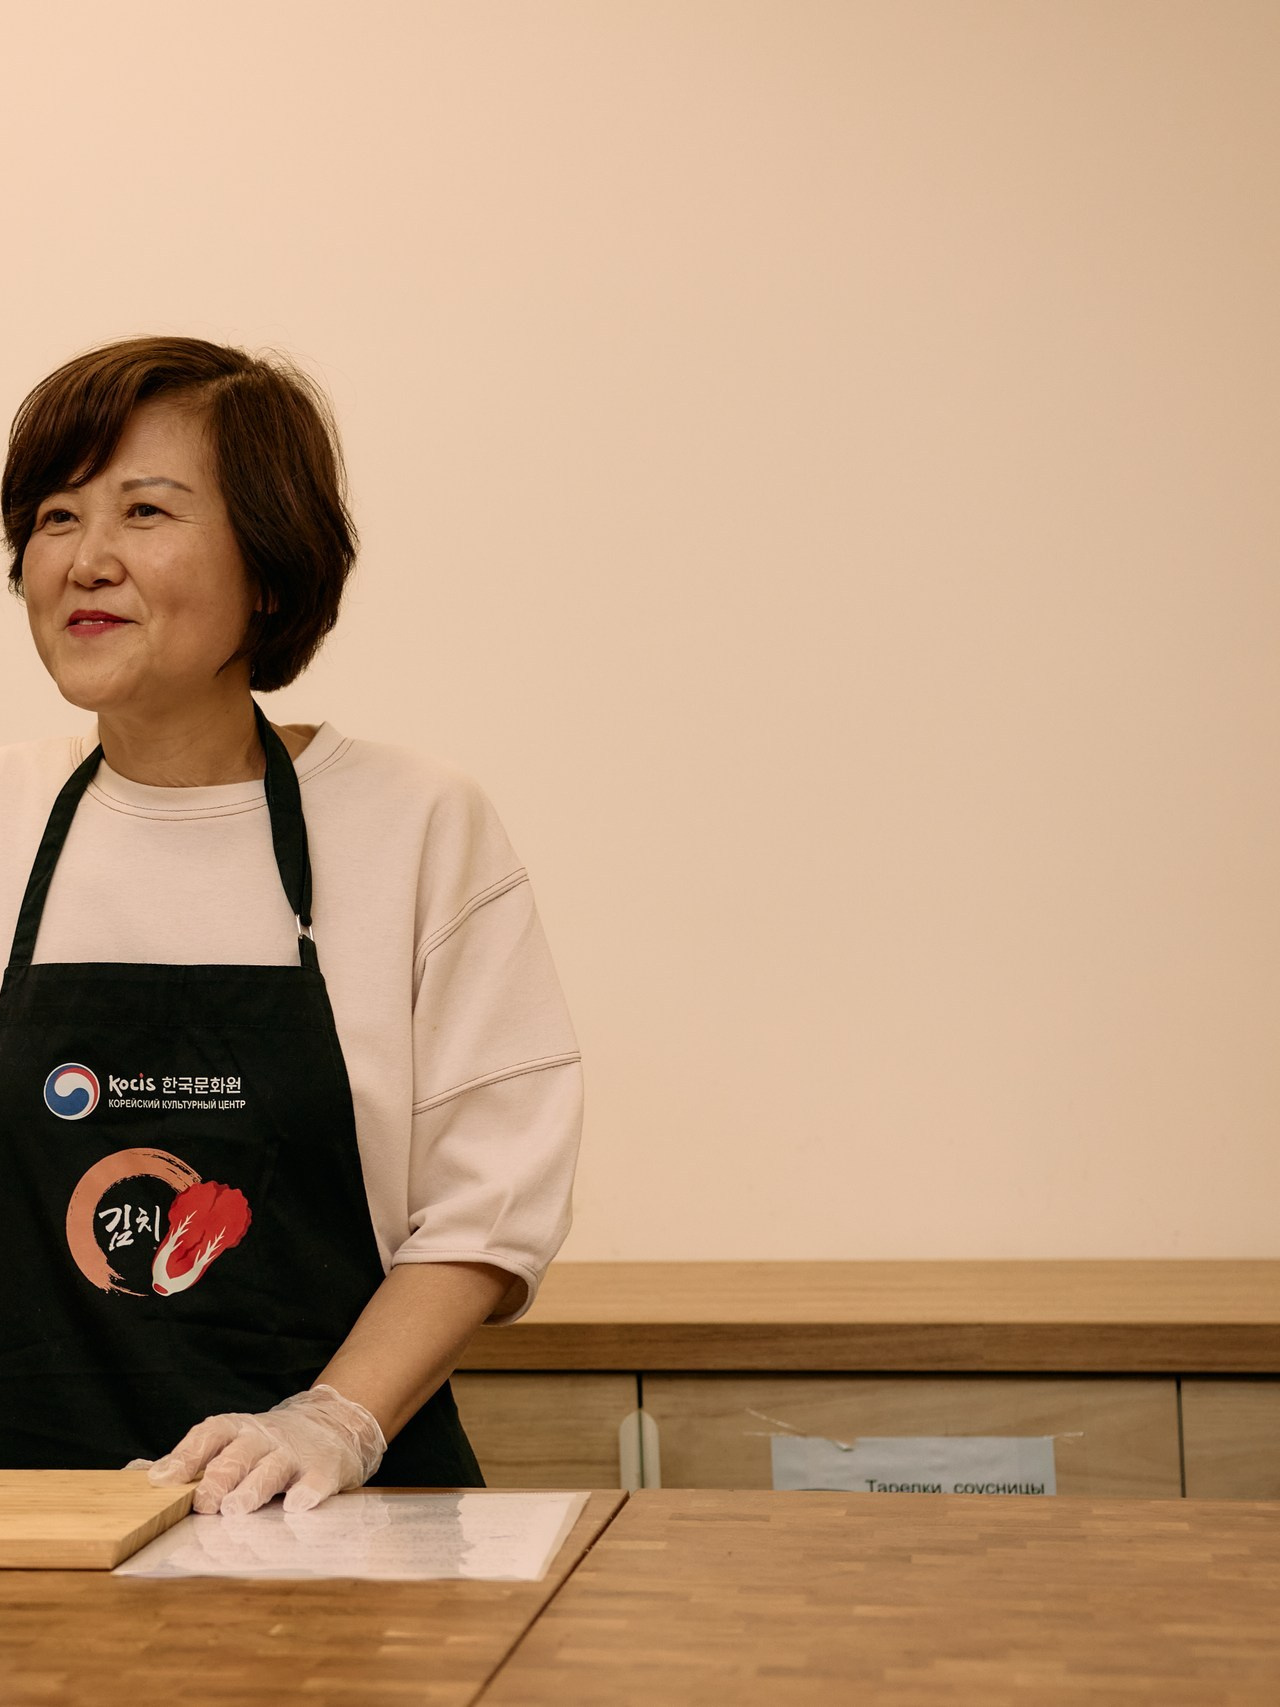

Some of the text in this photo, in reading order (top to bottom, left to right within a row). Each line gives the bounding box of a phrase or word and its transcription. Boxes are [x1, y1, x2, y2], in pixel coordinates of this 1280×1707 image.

[161, 1076, 241, 1095] 한국문화원
[108, 1098, 246, 1111] КОРЕЙСКИЙ КУЛЬТУРНЫЙ ЦЕНТР
[98, 1203, 161, 1252] 김치
